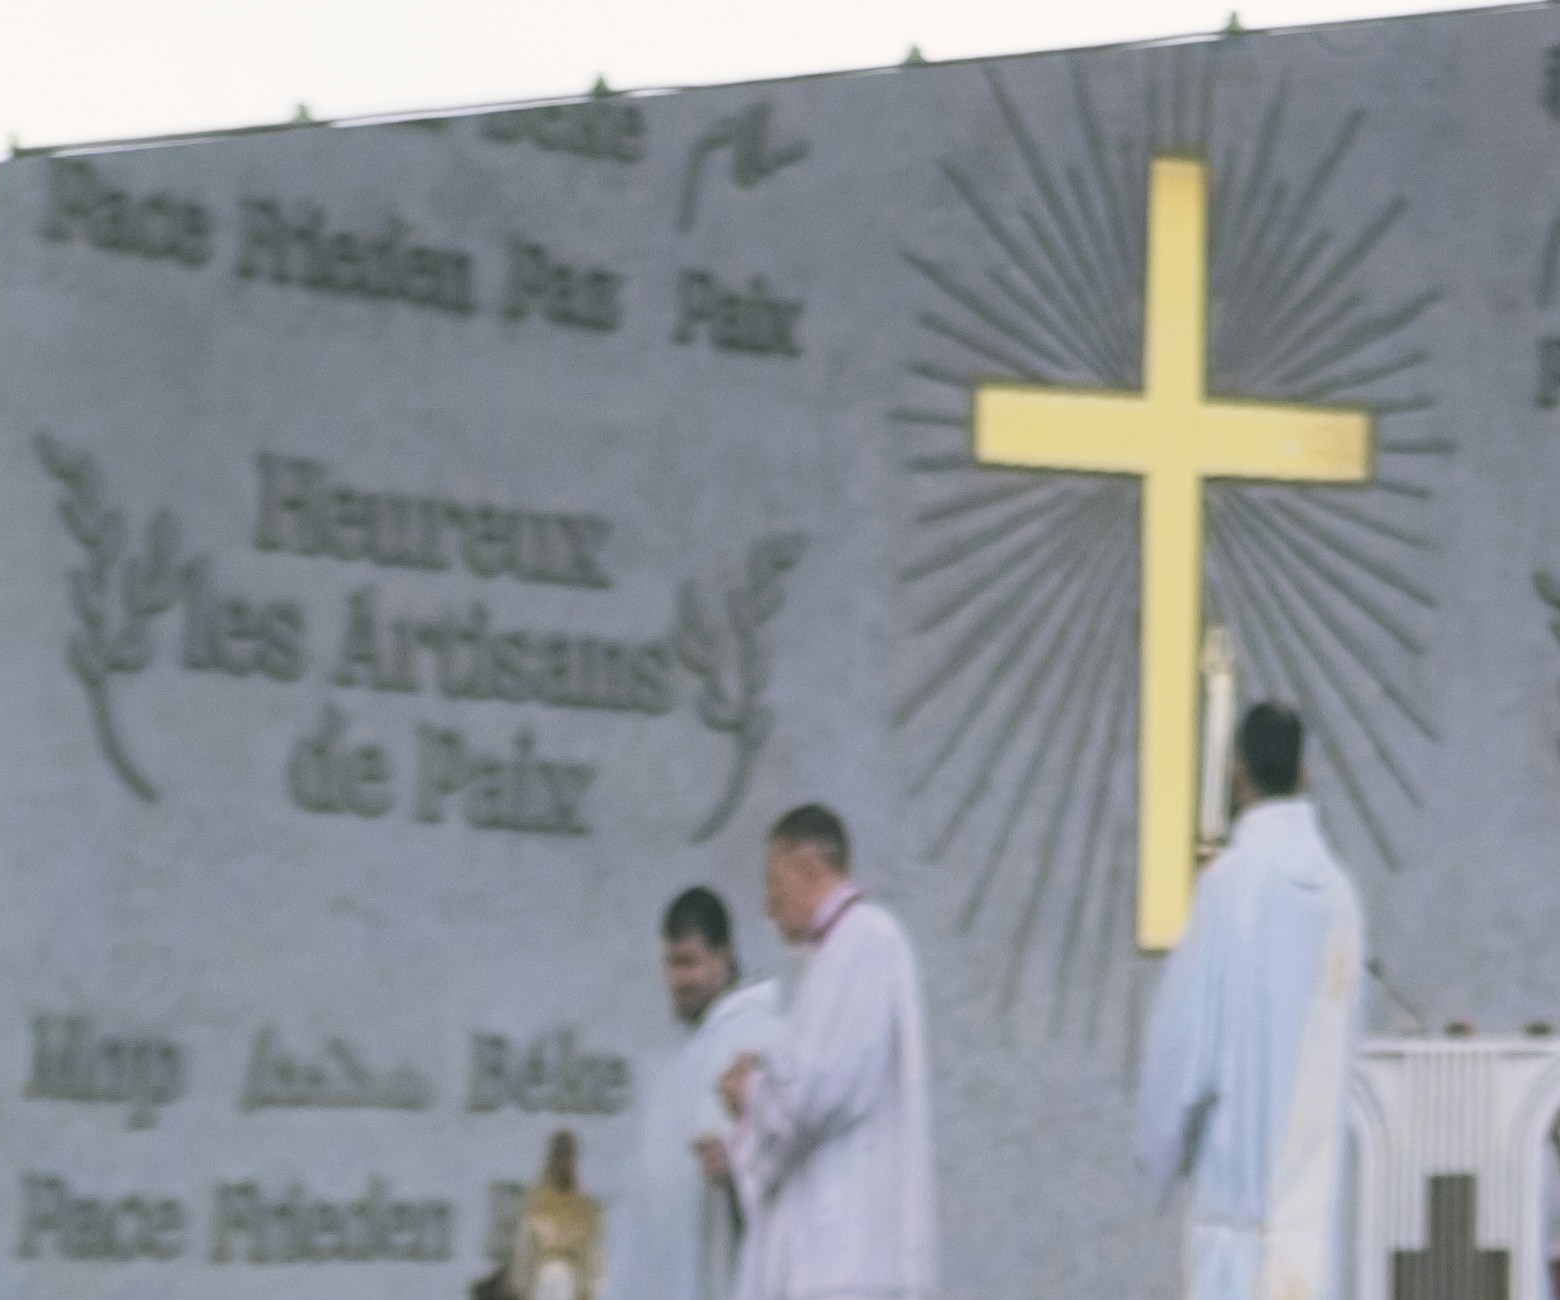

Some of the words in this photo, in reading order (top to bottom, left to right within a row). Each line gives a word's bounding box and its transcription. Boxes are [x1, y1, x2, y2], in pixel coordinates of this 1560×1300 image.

[236, 193, 476, 316] Frieden
[671, 267, 807, 360] Paix
[254, 448, 614, 590] Heureux
[182, 562, 308, 682] les
[333, 584, 675, 717] Artisans
[285, 700, 397, 818] de
[411, 720, 599, 838] Paix
[209, 1173, 456, 1265] Frieden
